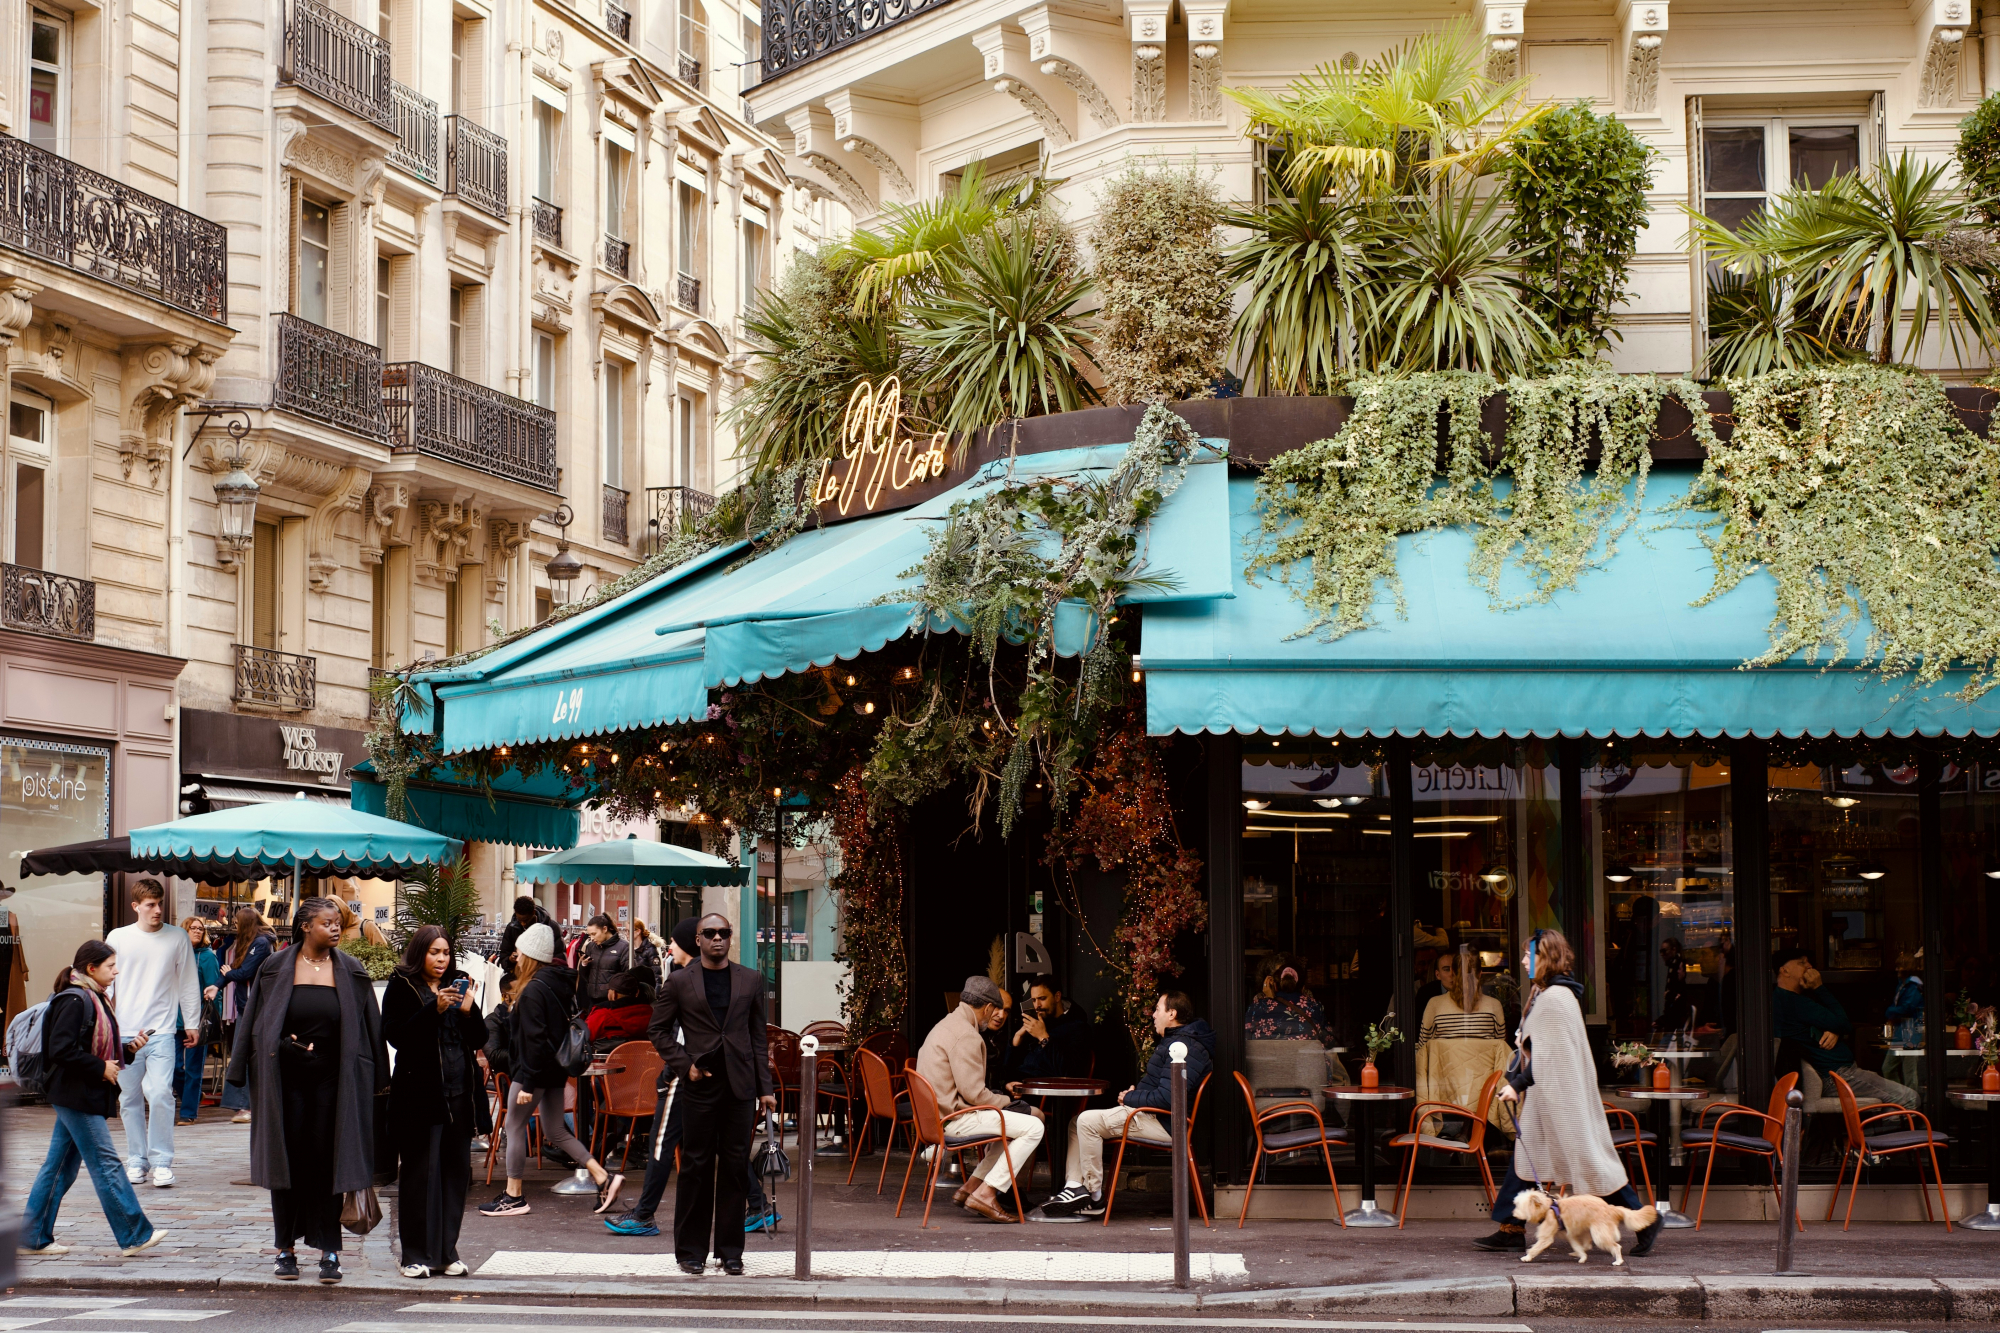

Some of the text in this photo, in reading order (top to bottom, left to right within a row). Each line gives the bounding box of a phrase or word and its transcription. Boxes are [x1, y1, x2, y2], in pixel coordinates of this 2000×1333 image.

[815, 457, 840, 505] Le
[838, 375, 901, 516] 99
[552, 687, 584, 724] Le 99
[22, 771, 87, 802] piscine
[271, 903, 289, 918] 10€
[349, 903, 361, 913] 10€
[375, 909, 388, 919] 20€
